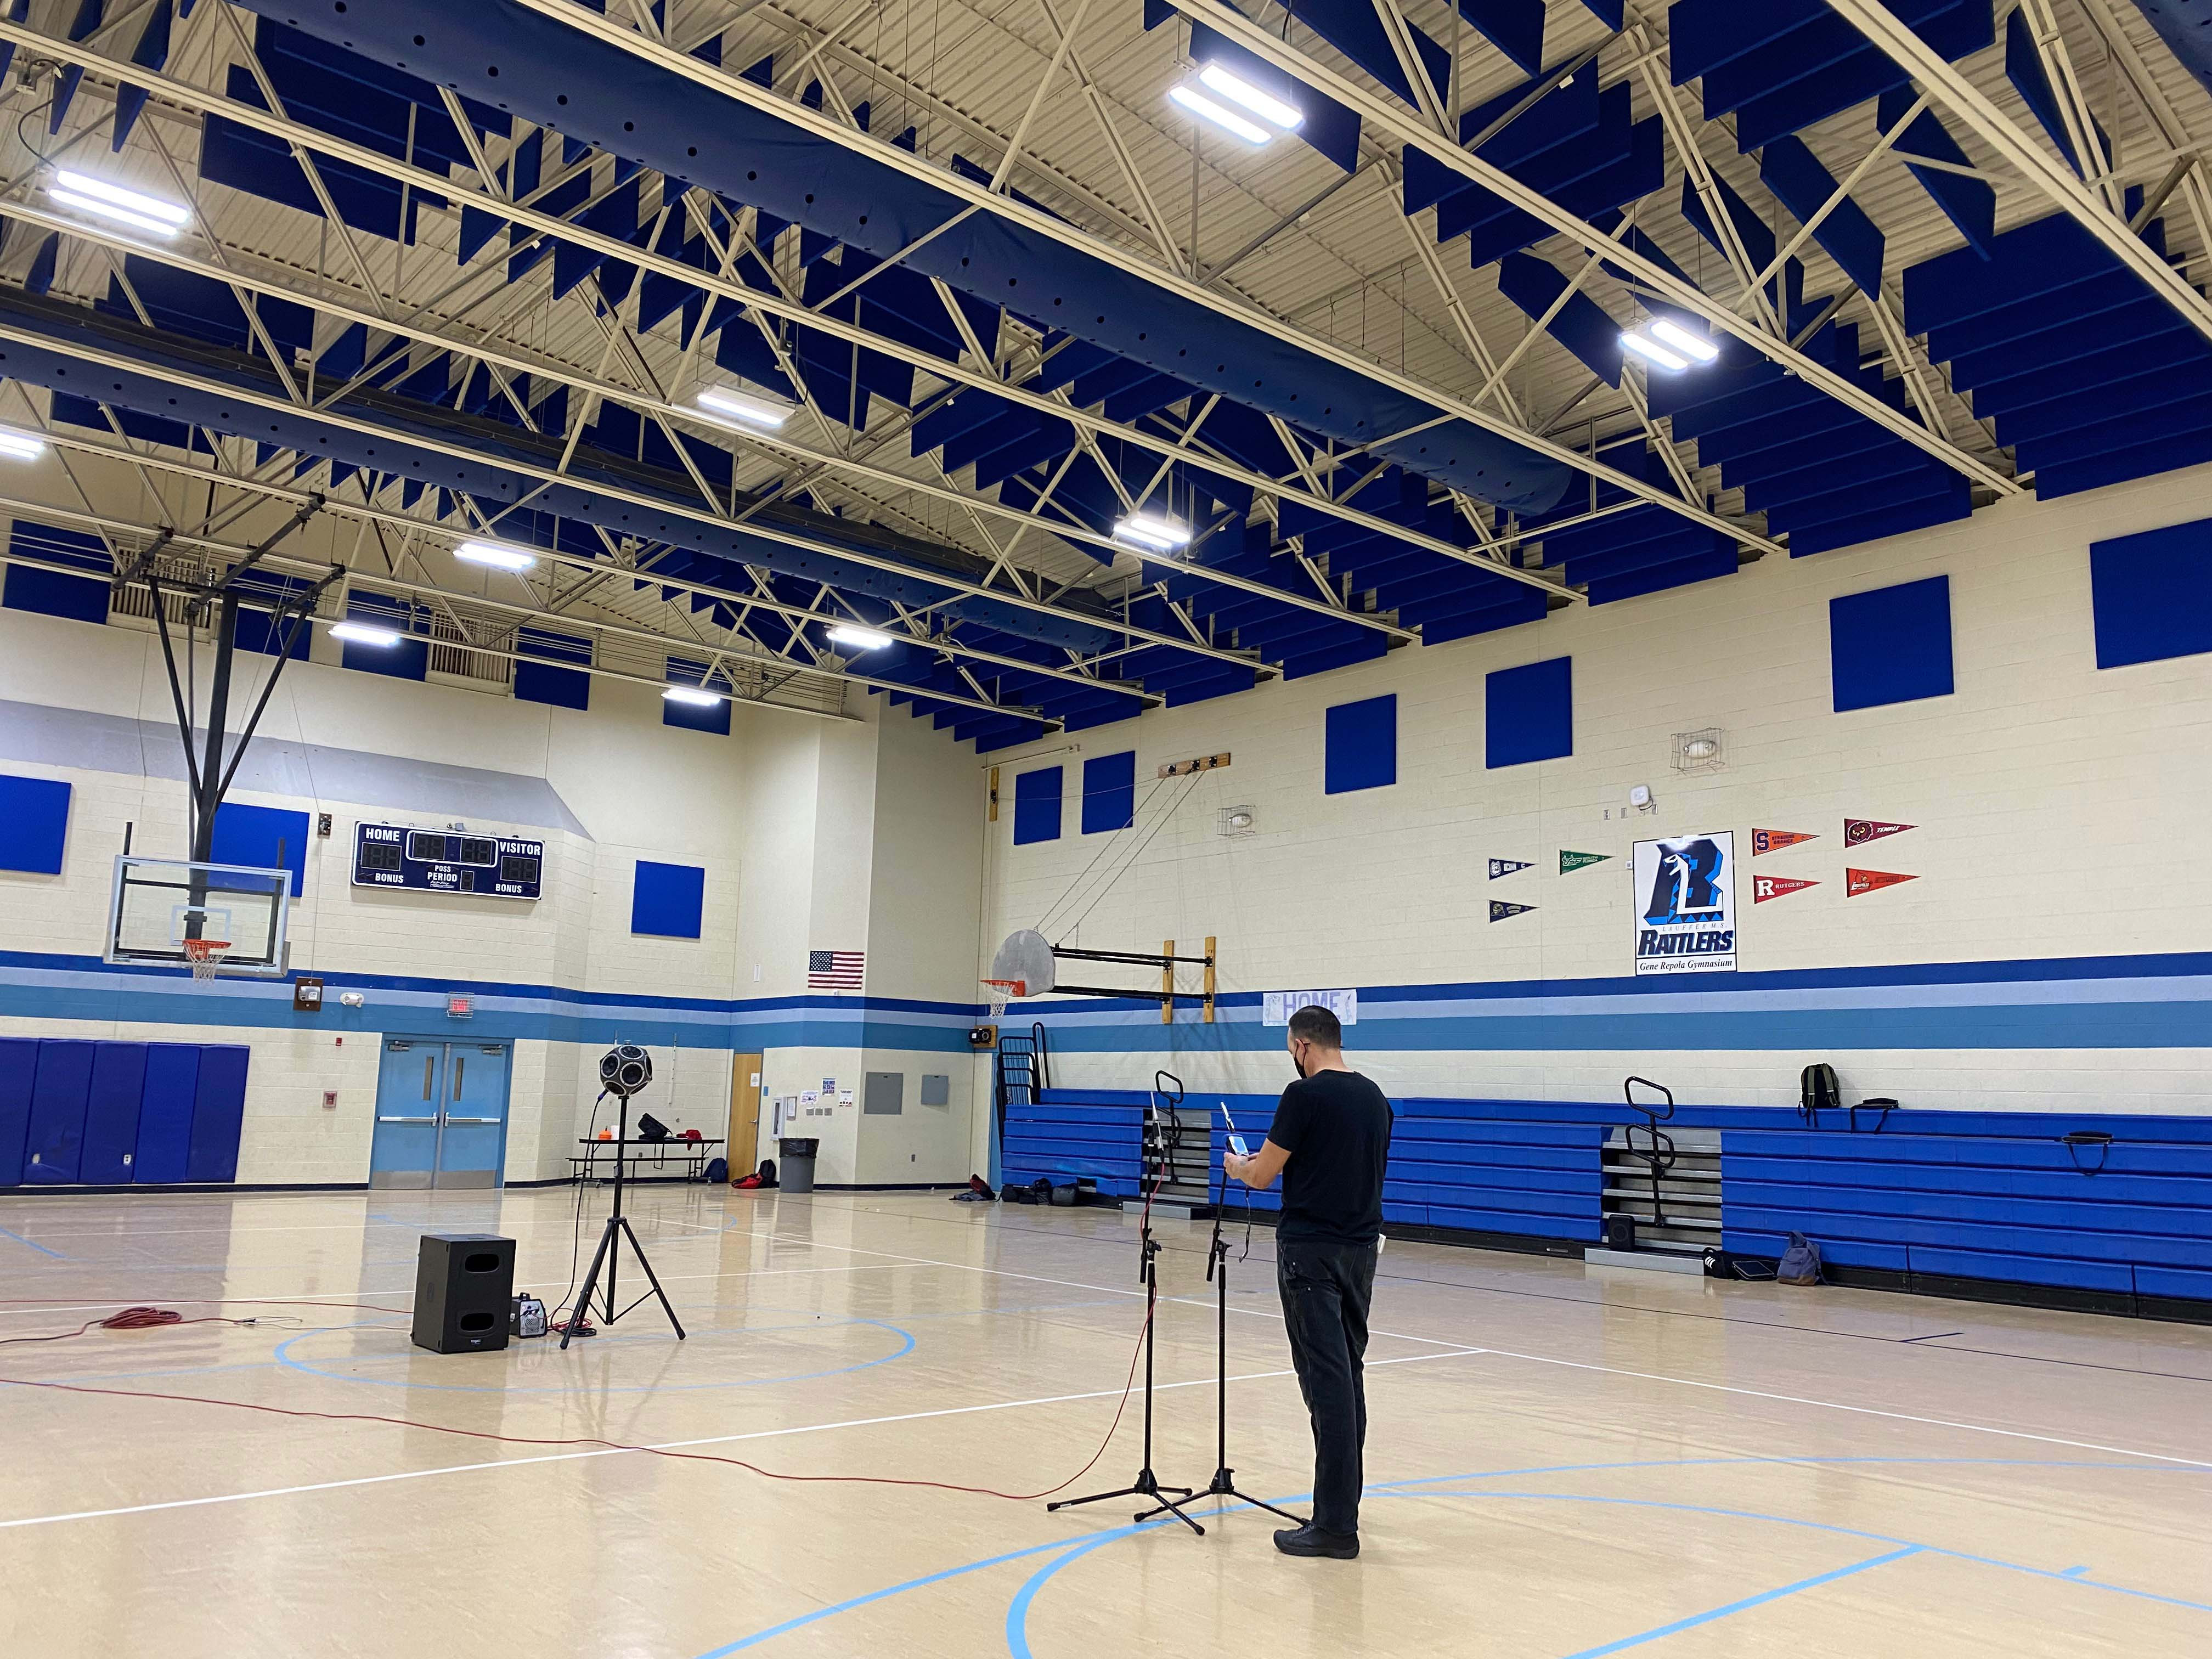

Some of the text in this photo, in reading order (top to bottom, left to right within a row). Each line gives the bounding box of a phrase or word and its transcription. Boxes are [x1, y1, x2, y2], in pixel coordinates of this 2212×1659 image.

[365, 827, 400, 842] HOME
[1756, 832, 1769, 850] S
[499, 841, 540, 856] VISITOR
[375, 873, 404, 883] BONUS
[427, 871, 458, 882] PERIOD
[495, 883, 522, 893] BONUS
[1757, 879, 1775, 896] R
[1662, 923, 1707, 932] LAUFFER
[1638, 929, 1734, 956] RATTLERS
[1640, 958, 1733, 971] Gene Repola Gymnasium
